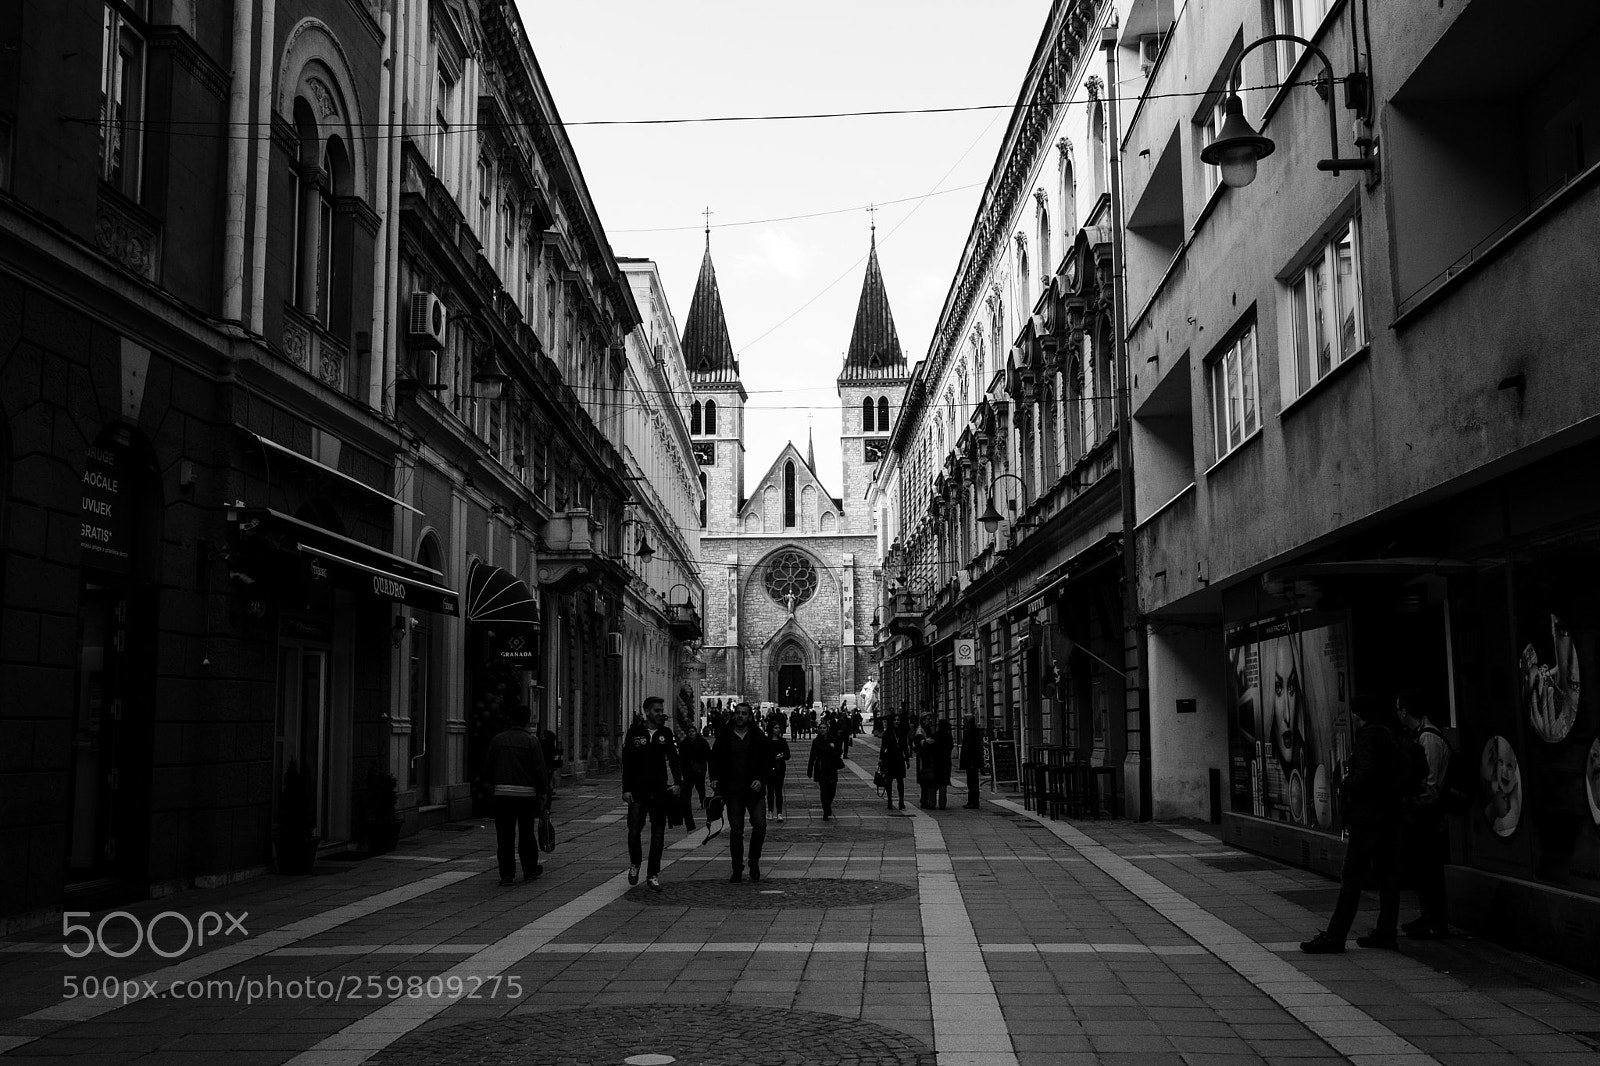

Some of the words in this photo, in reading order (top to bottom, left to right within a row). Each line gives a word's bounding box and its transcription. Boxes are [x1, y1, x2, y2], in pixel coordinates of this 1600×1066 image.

[82, 471, 118, 493] AOČALE
[82, 496, 112, 517] UVIJEK
[373, 575, 406, 599] QUADRO
